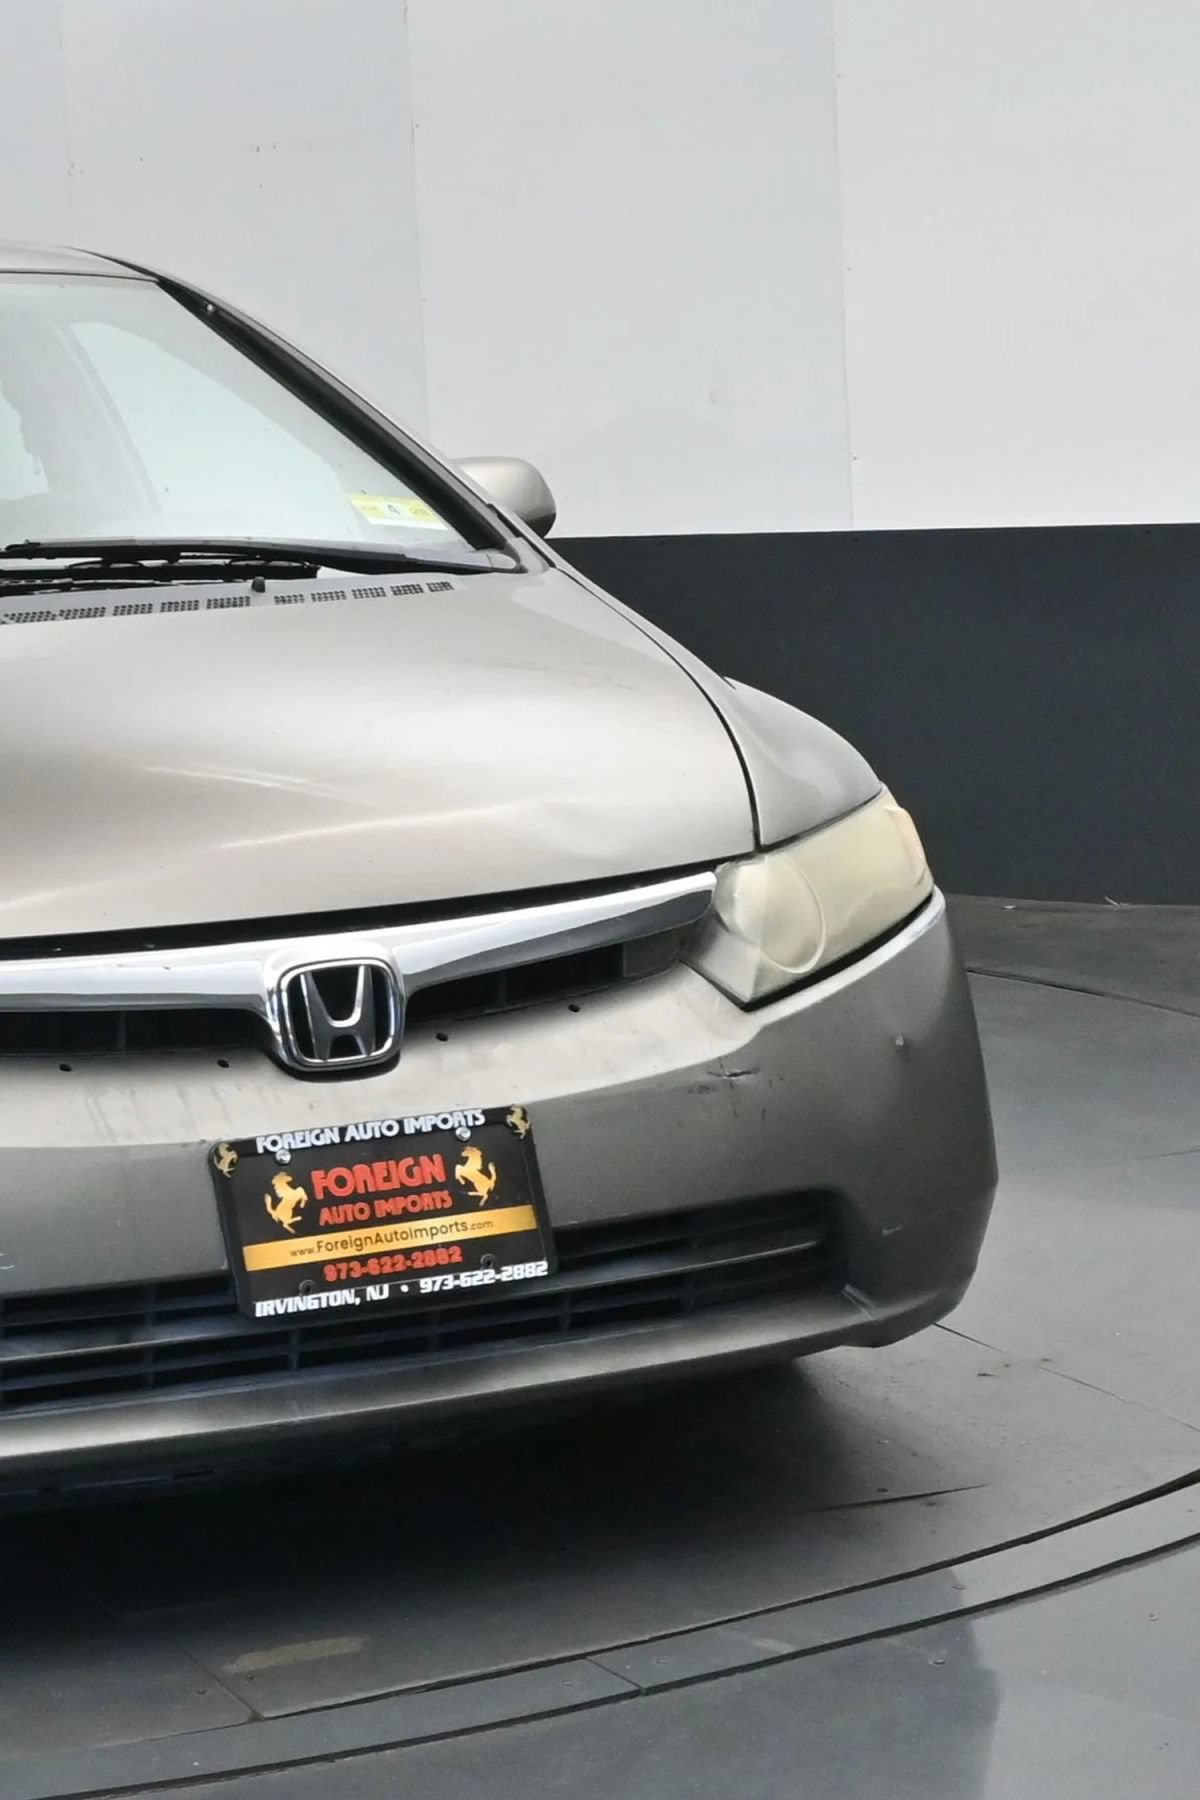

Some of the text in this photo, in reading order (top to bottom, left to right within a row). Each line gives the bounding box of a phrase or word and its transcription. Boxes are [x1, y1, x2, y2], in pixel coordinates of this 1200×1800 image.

[257, 1109, 485, 1153] FOREIGN AUTO IMPORTS
[311, 1154, 446, 1200] FOREIGN
[320, 1190, 453, 1226] AUTO IMPORTS
[290, 1219, 493, 1257] www.ForeignAutoImports.com
[255, 1261, 549, 1317] IRVINGTON, NJ 973-622-2882
